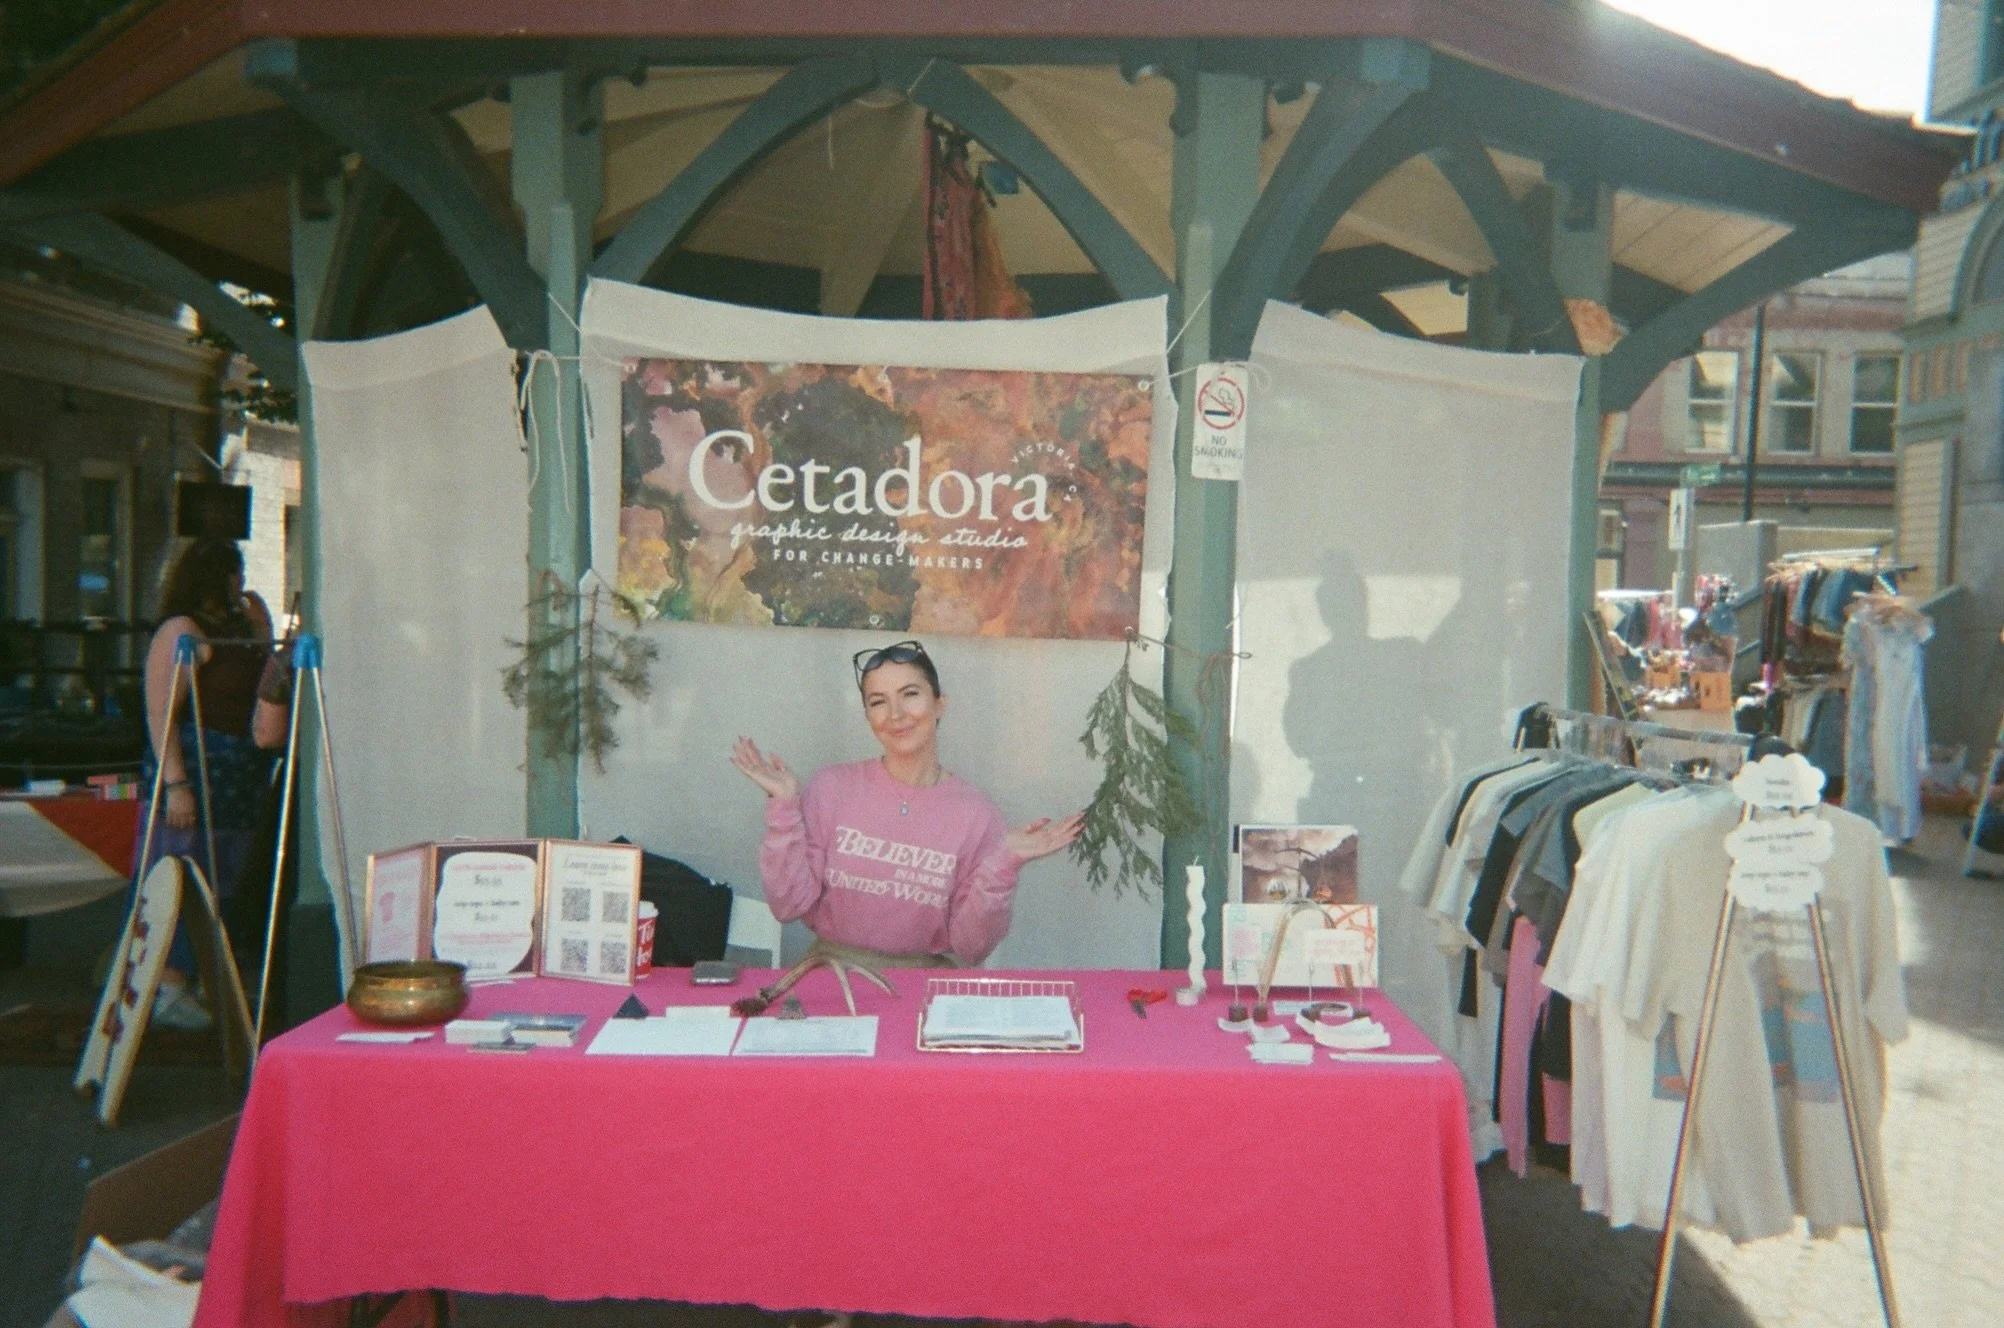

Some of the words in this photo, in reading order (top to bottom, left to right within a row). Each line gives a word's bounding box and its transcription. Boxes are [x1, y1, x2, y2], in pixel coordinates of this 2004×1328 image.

[1211, 434, 1228, 446] NO
[688, 430, 1053, 524] Cetadora
[729, 515, 832, 549] graphic
[842, 520, 929, 556] design
[939, 526, 1029, 548] studio
[773, 548, 808, 561] FOR
[821, 550, 984, 570] CHANGE-MAKERS
[824, 867, 890, 896] UNITED
